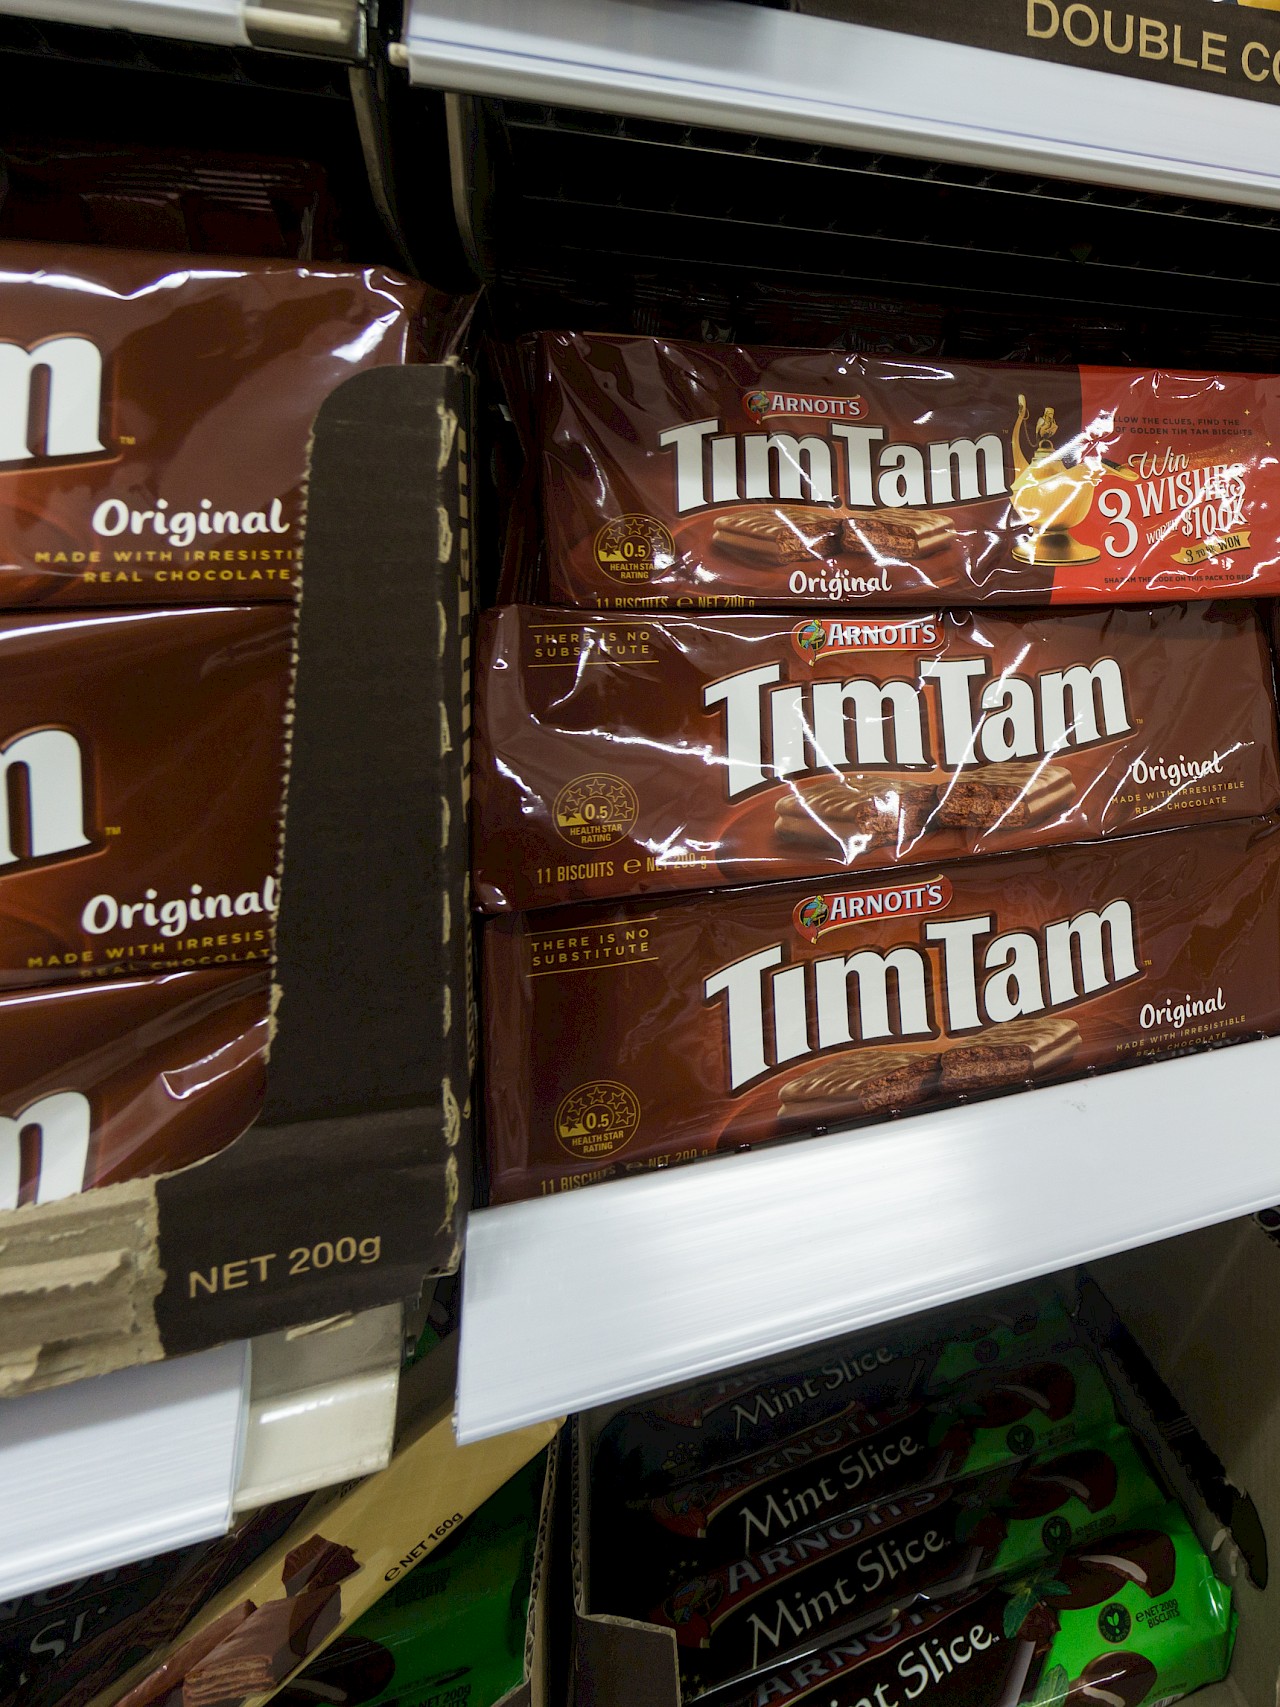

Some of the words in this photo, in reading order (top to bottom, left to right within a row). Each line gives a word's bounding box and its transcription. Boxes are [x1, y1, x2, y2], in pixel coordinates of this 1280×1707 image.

[1025, 0, 1228, 74] DOUBLE
[770, 394, 861, 416] ARNOTT'S
[1128, 446, 1190, 479] Win
[1098, 488, 1139, 558] 3
[1135, 462, 1246, 518] WISHES
[92, 498, 290, 547] Original
[624, 542, 646, 558] 0.5
[1218, 535, 1240, 550] WON
[35, 552, 100, 563] MADE
[114, 551, 172, 561] WITH
[610, 563, 639, 571] HEALTH
[83, 571, 141, 582] REAL
[155, 569, 291, 582] CHOCOLATE
[789, 569, 892, 600] Original
[698, 597, 718, 608] NET
[534, 633, 591, 643] THERE
[628, 632, 650, 641] NO
[827, 619, 936, 646] ARNOTT'S
[535, 644, 650, 657] SUBSTITUTE
[1132, 751, 1223, 786] Original
[1112, 795, 1141, 804] MADE
[1146, 789, 1176, 799] WITH
[1178, 782, 1245, 795] IRRESISTIBLE
[1168, 796, 1227, 810] CHOCOLATE
[585, 803, 608, 820] 0.5
[570, 827, 600, 836] HEALTH
[602, 824, 622, 832] STAR
[581, 834, 611, 843] RATING
[537, 868, 551, 884] 11
[558, 862, 614, 882] BISCUITS
[82, 876, 279, 937] Original
[830, 882, 943, 921] ARNOTT'S
[532, 938, 590, 952] THERE
[601, 933, 615, 943] IS
[626, 928, 649, 939] NO
[27, 950, 93, 968] MADE
[106, 941, 166, 959] WITH
[532, 942, 649, 966] SUBSTITUTE
[1140, 987, 1226, 1028] Original
[1116, 1039, 1144, 1051] MADE
[1150, 1033, 1176, 1043] WITH
[1181, 1015, 1246, 1036] IRRESISTIBLE
[586, 1113, 609, 1129] 0.5
[572, 1136, 602, 1146] HEALTH
[604, 1131, 623, 1140] STAR
[583, 1142, 612, 1153] RATING
[541, 1180, 555, 1195] 11
[189, 1252, 277, 1298] NET
[289, 1236, 381, 1275] 200g
[731, 1383, 819, 1439] Mint
[821, 1345, 893, 1390] Slice
[739, 1485, 839, 1556] Mint
[839, 1435, 920, 1490] Slice
[399, 1543, 431, 1571] NET
[427, 1511, 464, 1544] 160g
[747, 1577, 856, 1670] Mint
[857, 1530, 945, 1593] Slice
[1144, 1607, 1159, 1622] NET
[1147, 1608, 1180, 1629] BISCUITS
[898, 1624, 993, 1700] Slice
